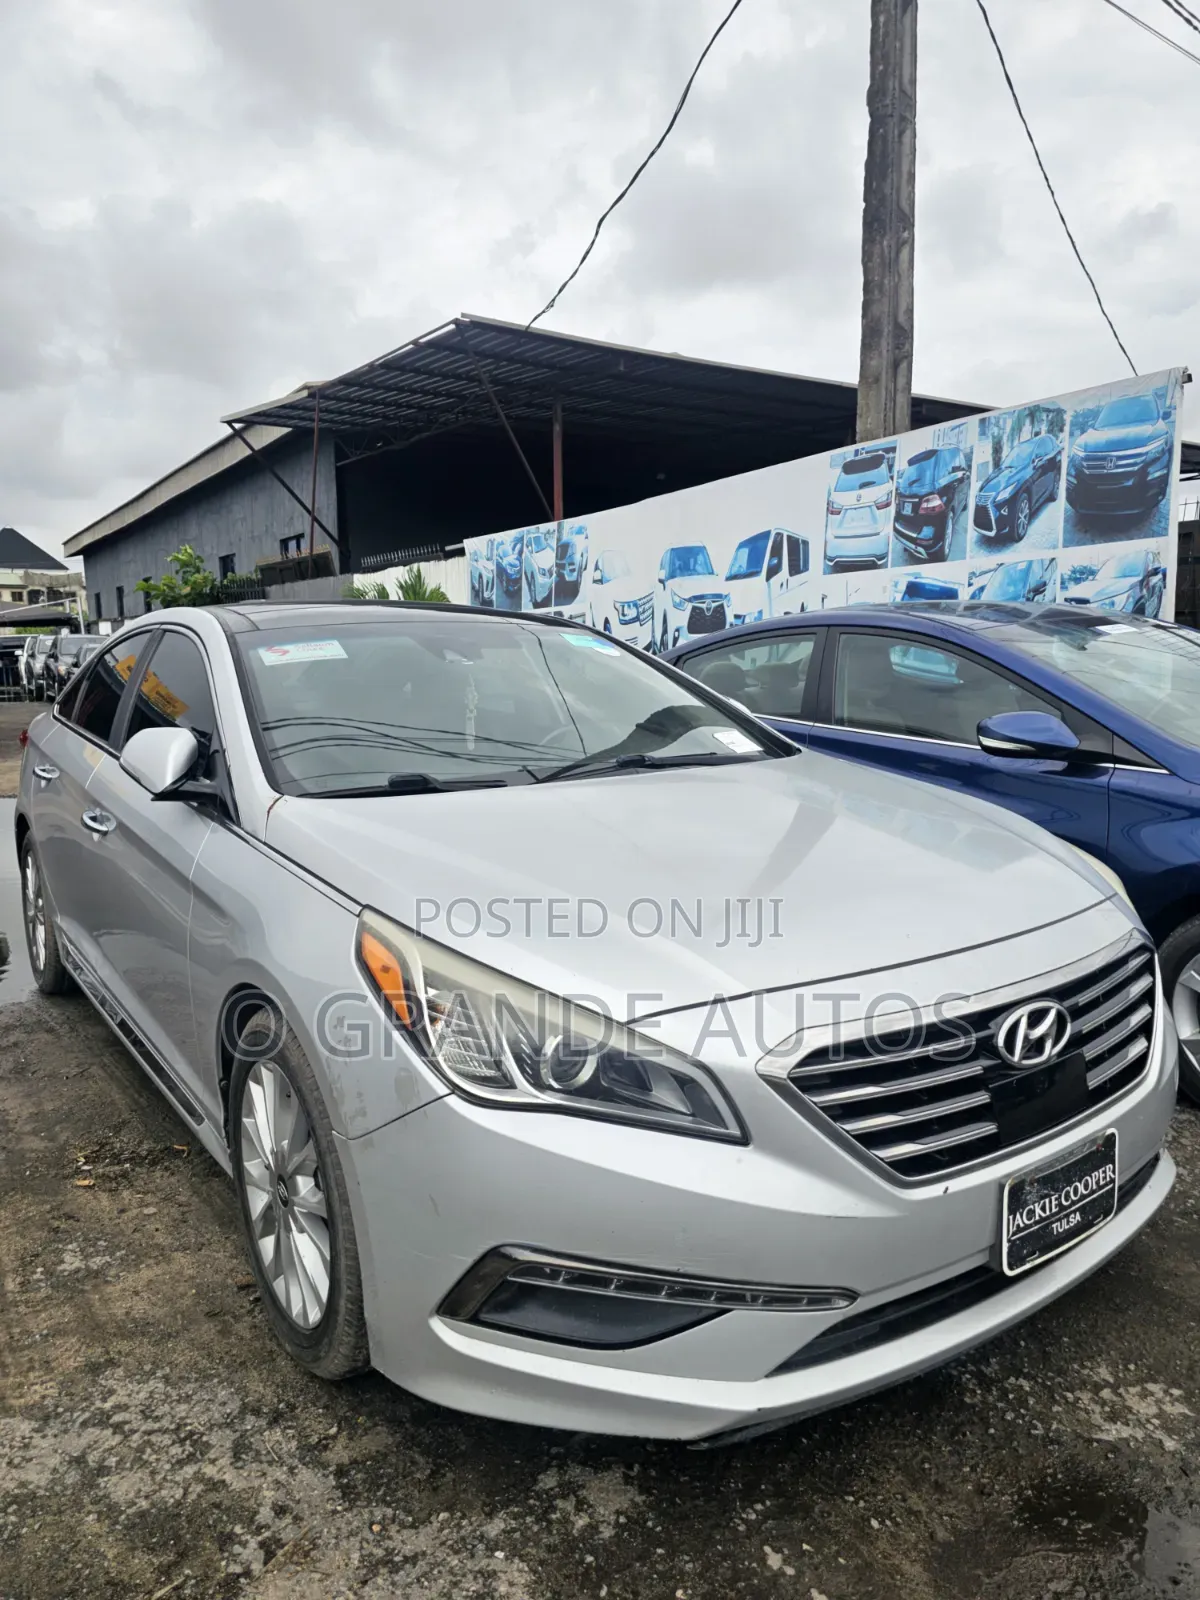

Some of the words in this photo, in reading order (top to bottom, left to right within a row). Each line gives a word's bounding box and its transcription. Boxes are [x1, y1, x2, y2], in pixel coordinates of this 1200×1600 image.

[1008, 1194, 1059, 1239] JACKIE
[1061, 1163, 1115, 1206] COOPER
[1052, 1211, 1081, 1235] TULSA
